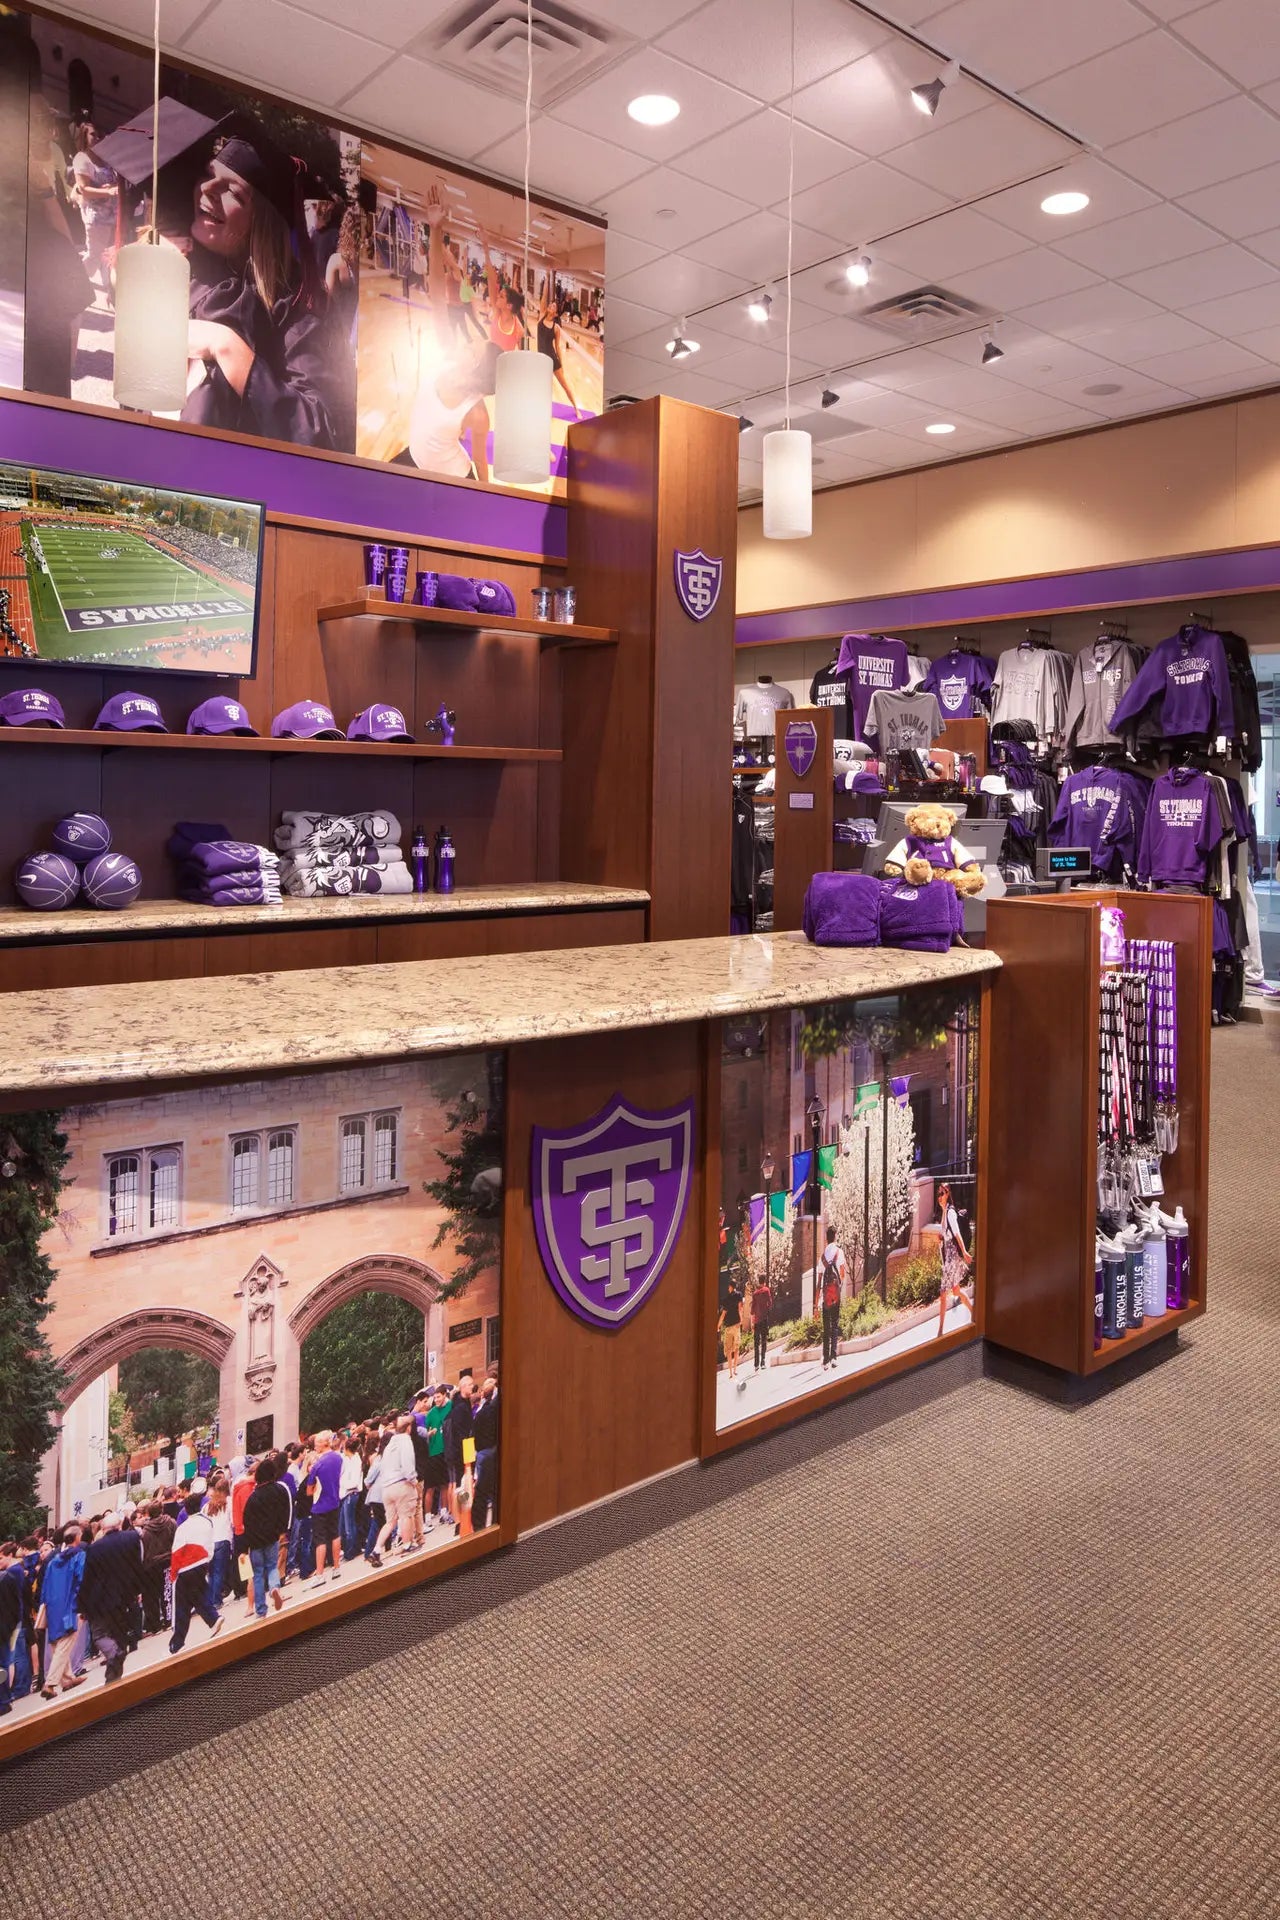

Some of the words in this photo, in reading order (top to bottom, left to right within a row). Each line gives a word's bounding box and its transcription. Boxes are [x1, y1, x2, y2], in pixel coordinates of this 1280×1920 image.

[79, 604, 214, 626] THOMAS
[858, 655, 895, 673] UNIVERSITY
[869, 671, 893, 688] THOMAS
[901, 713, 929, 736] THOMAS
[1116, 1274, 1125, 1289] ST.
[1133, 1265, 1143, 1279] ST.
[1116, 1289, 1126, 1329] THOMAS
[1133, 1280, 1143, 1318] THOMAS
